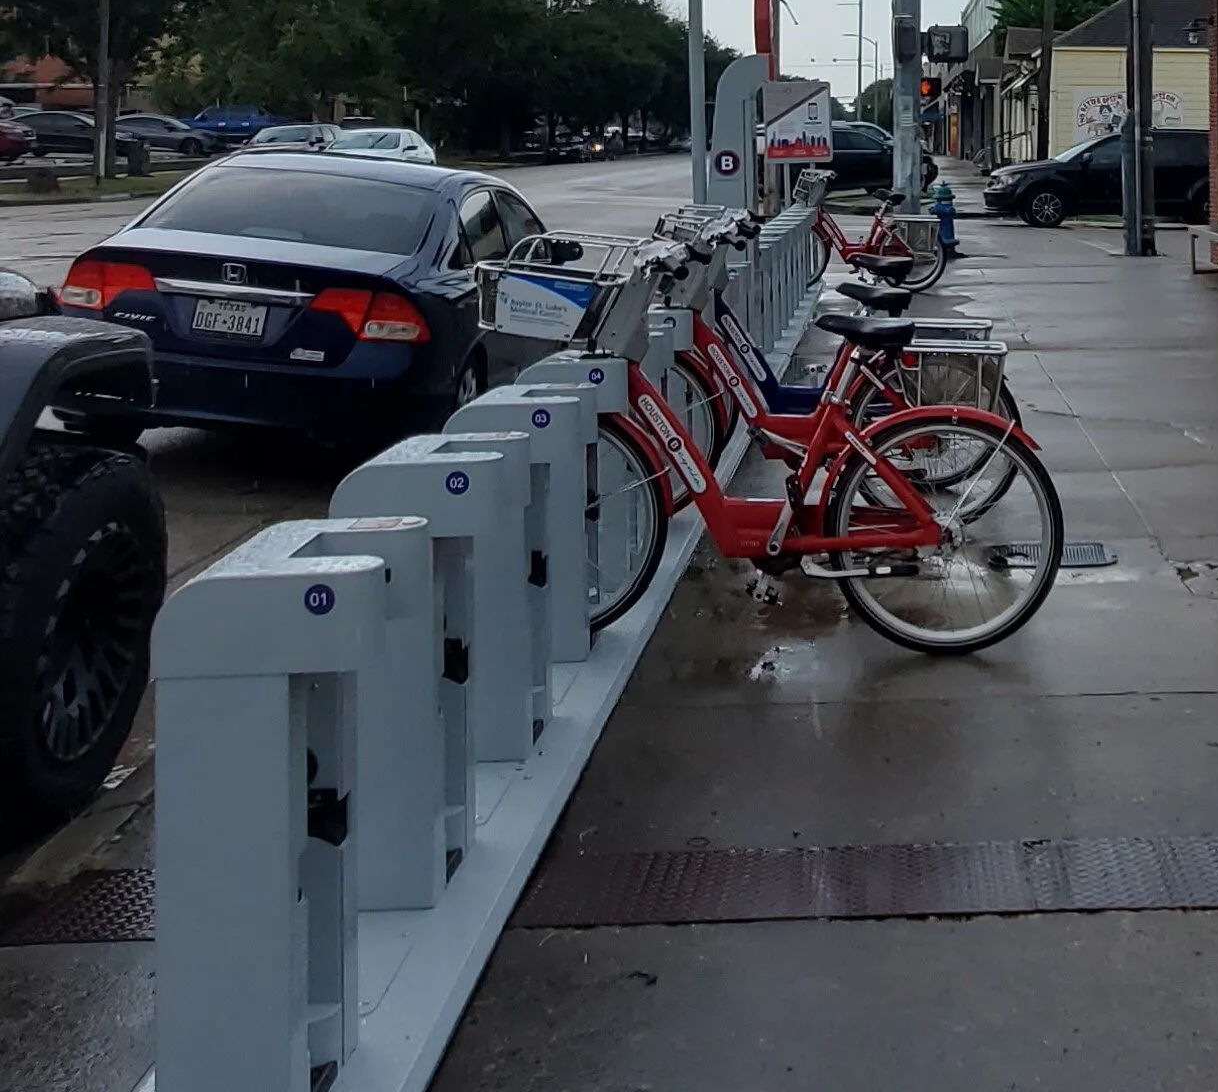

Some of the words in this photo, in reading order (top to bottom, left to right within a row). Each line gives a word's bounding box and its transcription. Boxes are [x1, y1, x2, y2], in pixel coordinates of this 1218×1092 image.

[720, 155, 734, 171] B
[219, 302, 247, 312] TEXAS
[113, 311, 157, 322] CIVIC
[590, 371, 602, 381] 04
[534, 413, 548, 424] 03
[641, 397, 672, 438] HOUSTON
[449, 476, 465, 490] 02
[309, 591, 329, 607] 01
